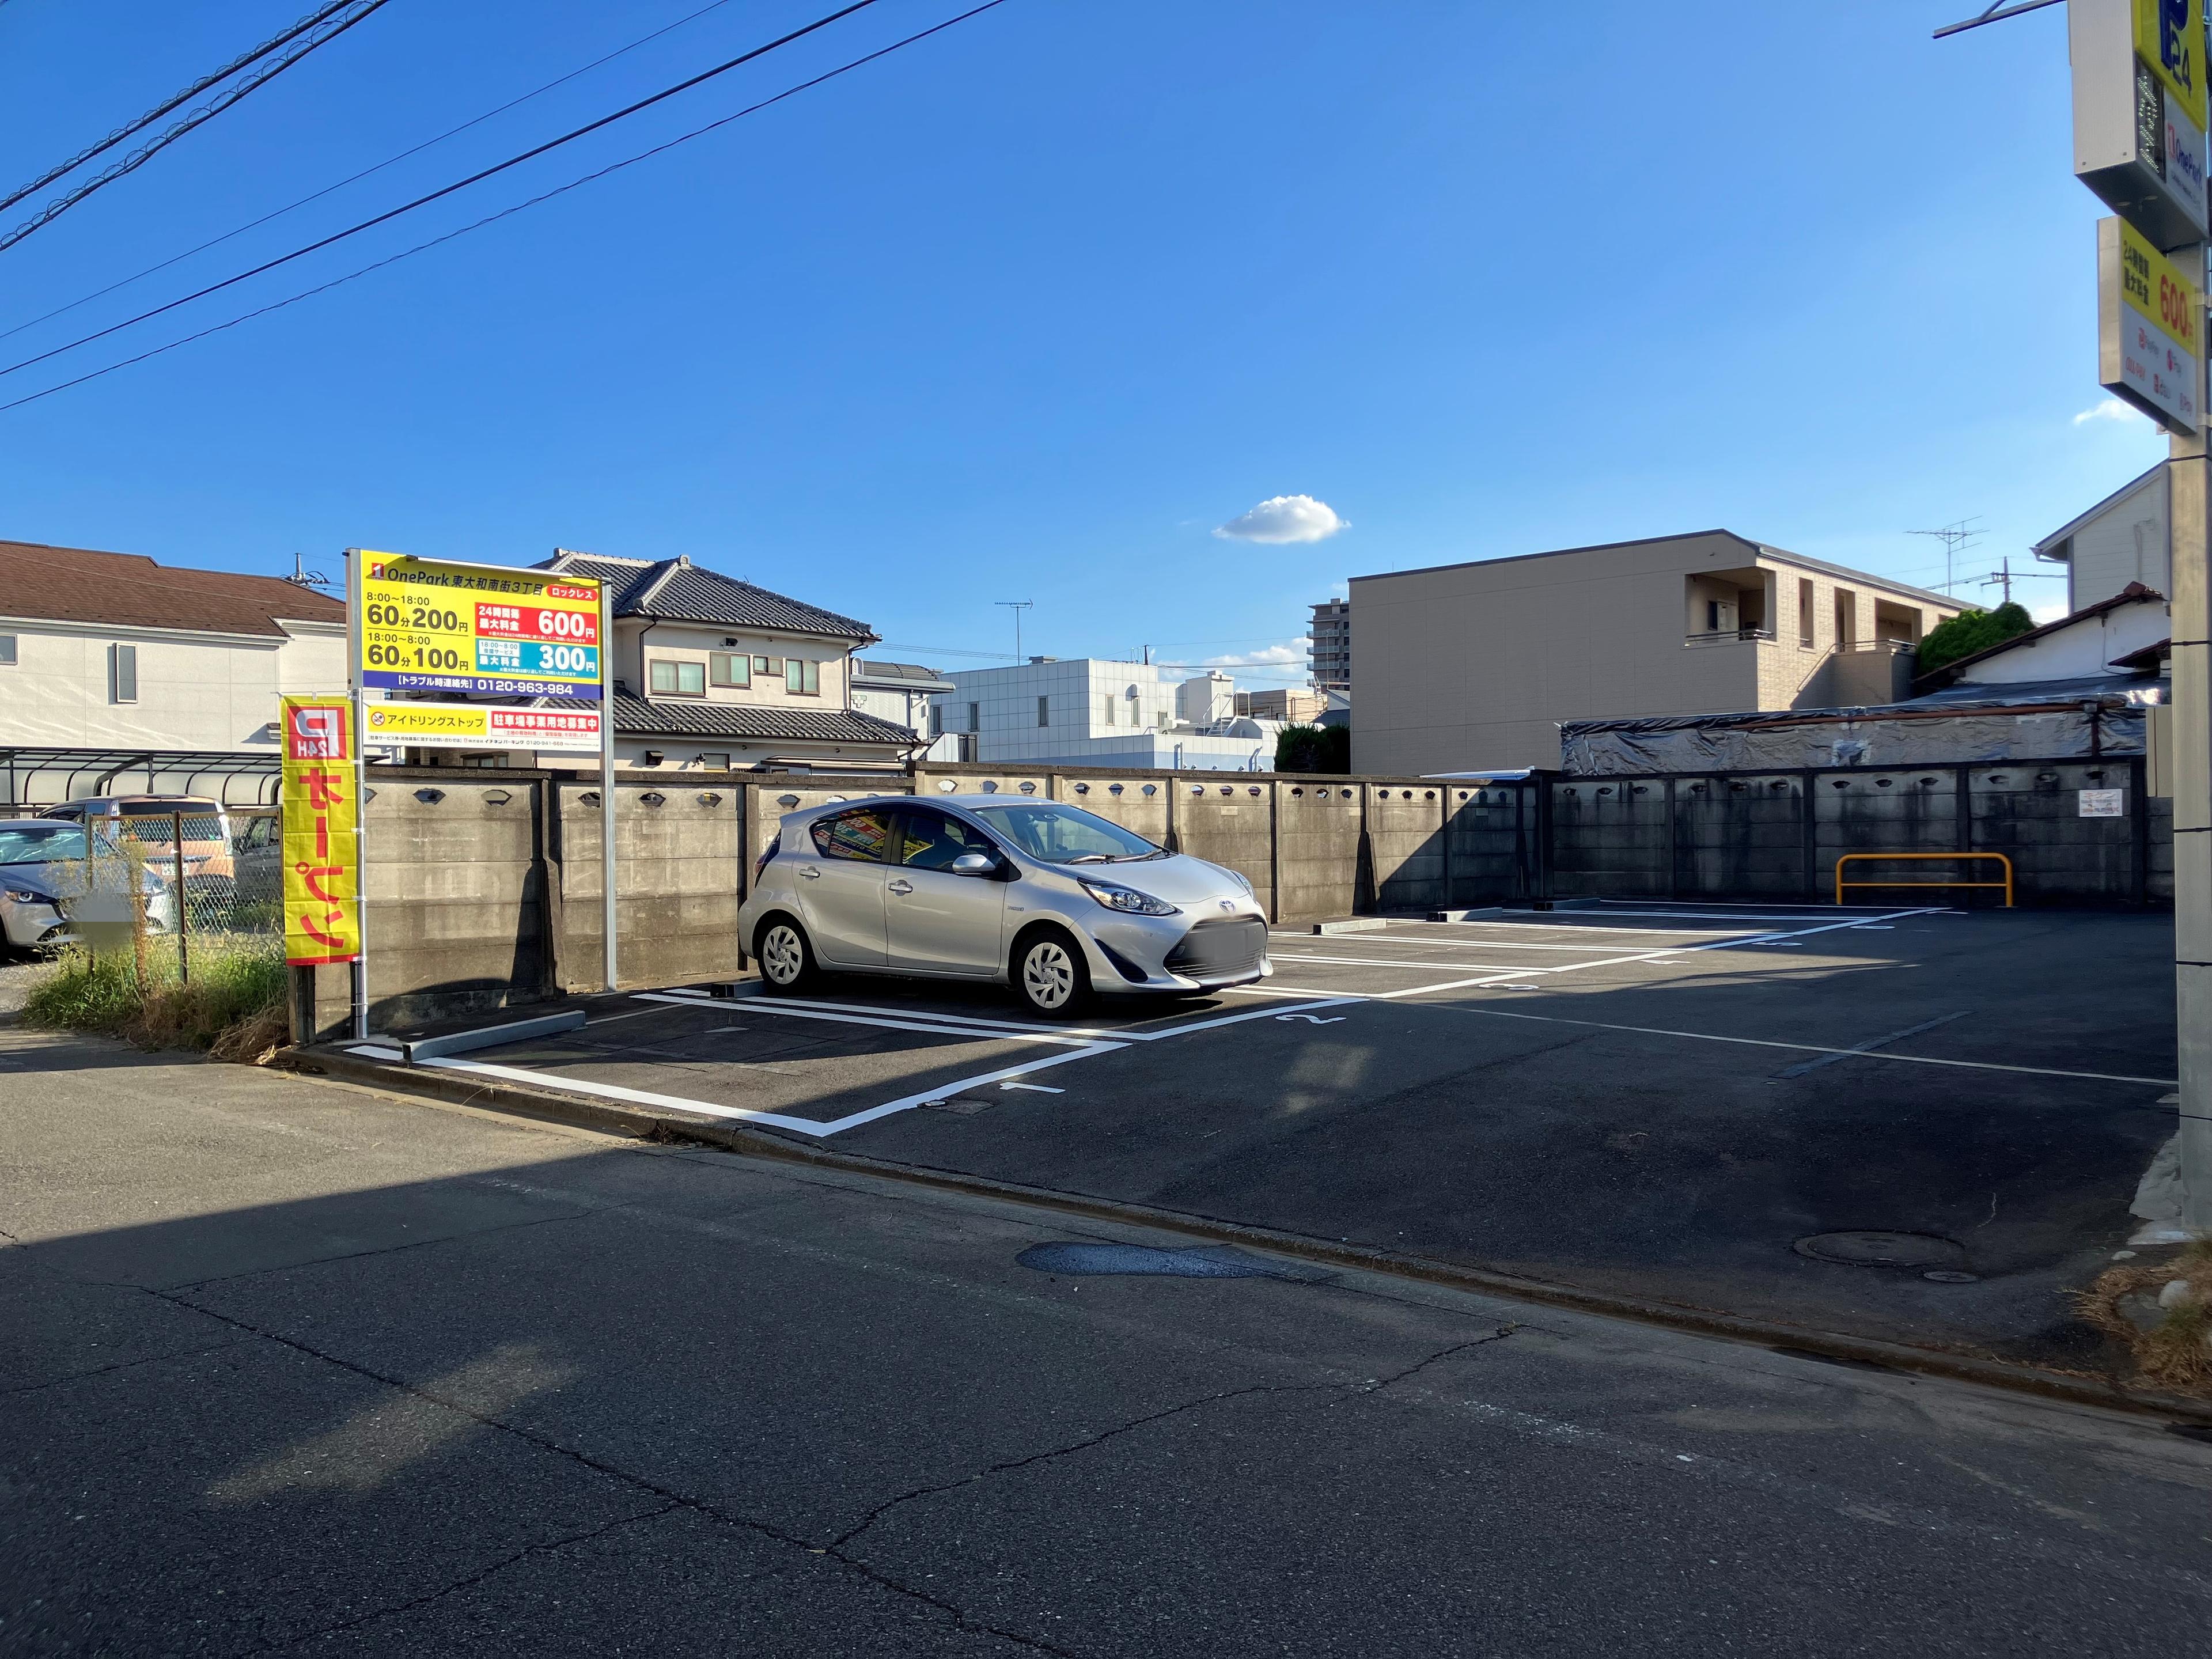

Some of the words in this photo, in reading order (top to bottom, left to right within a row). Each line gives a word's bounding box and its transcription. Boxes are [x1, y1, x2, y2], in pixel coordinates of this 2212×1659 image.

[388, 567, 449, 586] OnePark
[551, 587, 593, 600] ロックレス
[479, 618, 520, 631] 最大料金
[538, 610, 595, 639] 600円
[479, 656, 520, 667] 最大料金
[539, 645, 596, 673] 300円
[477, 679, 574, 695] 0120-963-984
[387, 714, 484, 728] アイドリングストップ
[493, 714, 597, 730] 駐車場事業用地募集中
[1275, 1014, 1347, 1024] 2
